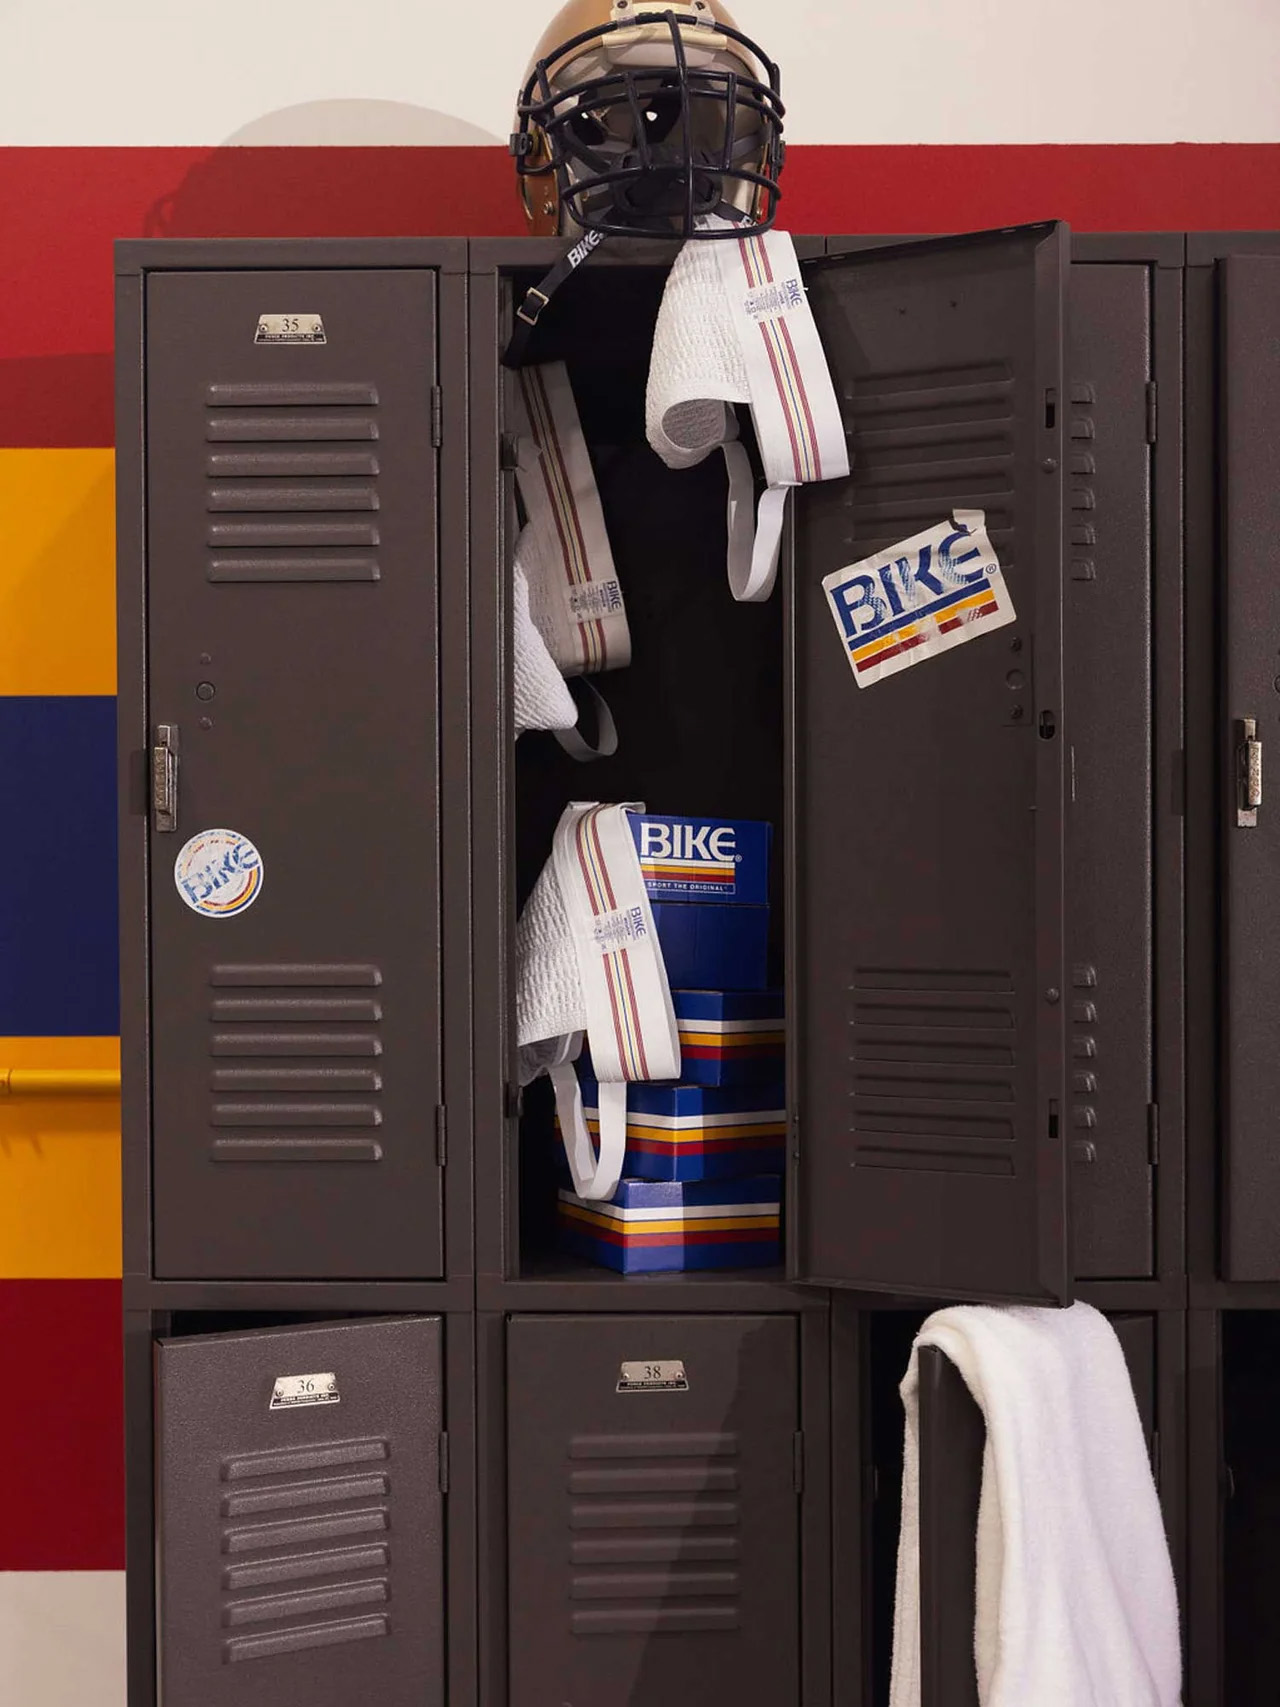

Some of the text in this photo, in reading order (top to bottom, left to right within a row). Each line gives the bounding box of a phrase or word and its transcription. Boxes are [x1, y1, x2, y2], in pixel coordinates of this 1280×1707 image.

[281, 318, 299, 332] 35
[607, 580, 622, 610] BIKE
[647, 881, 671, 889] SPORT
[690, 884, 724, 892] ORIGINAL
[630, 906, 647, 937] BIKE
[643, 1365, 662, 1380] 38
[296, 1378, 315, 1394] 36
